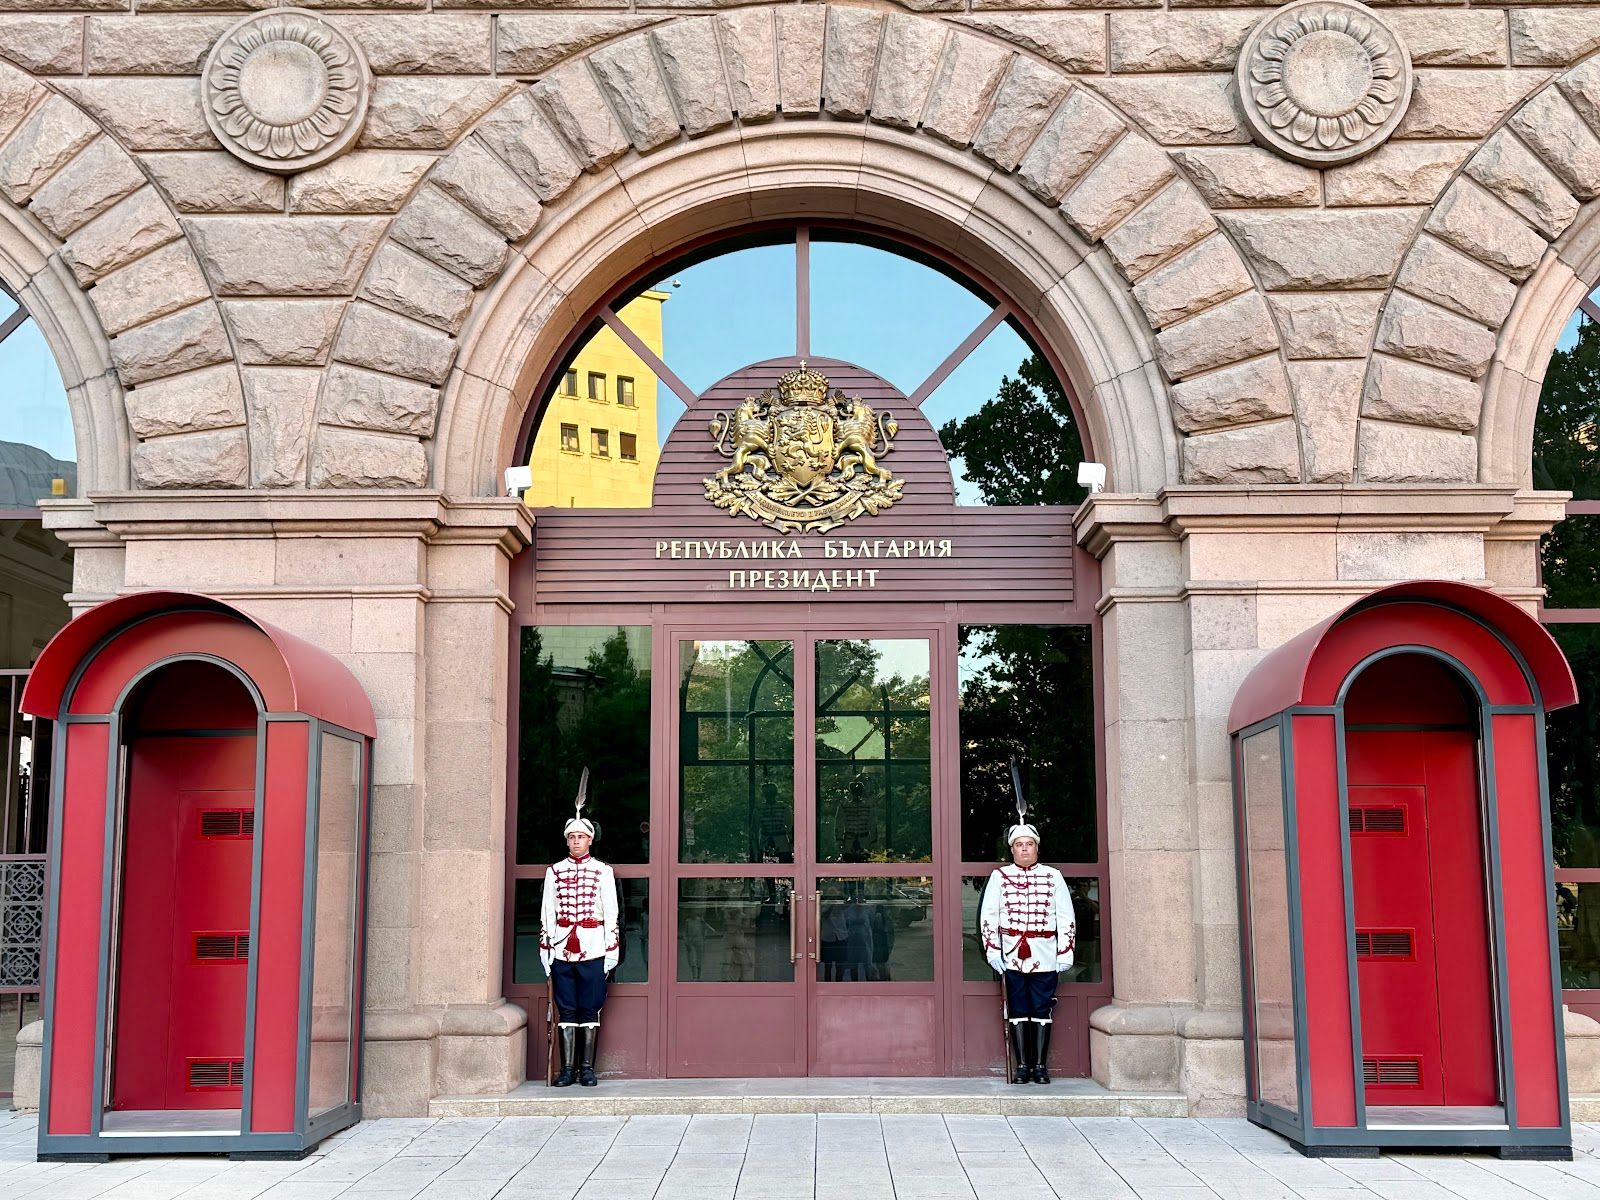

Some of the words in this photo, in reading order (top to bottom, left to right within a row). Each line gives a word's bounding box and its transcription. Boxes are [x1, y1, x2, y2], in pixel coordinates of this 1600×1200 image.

[655, 540, 803, 559] РЕПУБЛИКА
[824, 539, 953, 558] БЪЛГАРИЯ
[729, 569, 880, 593] ПРЕЗИДЕНТ
